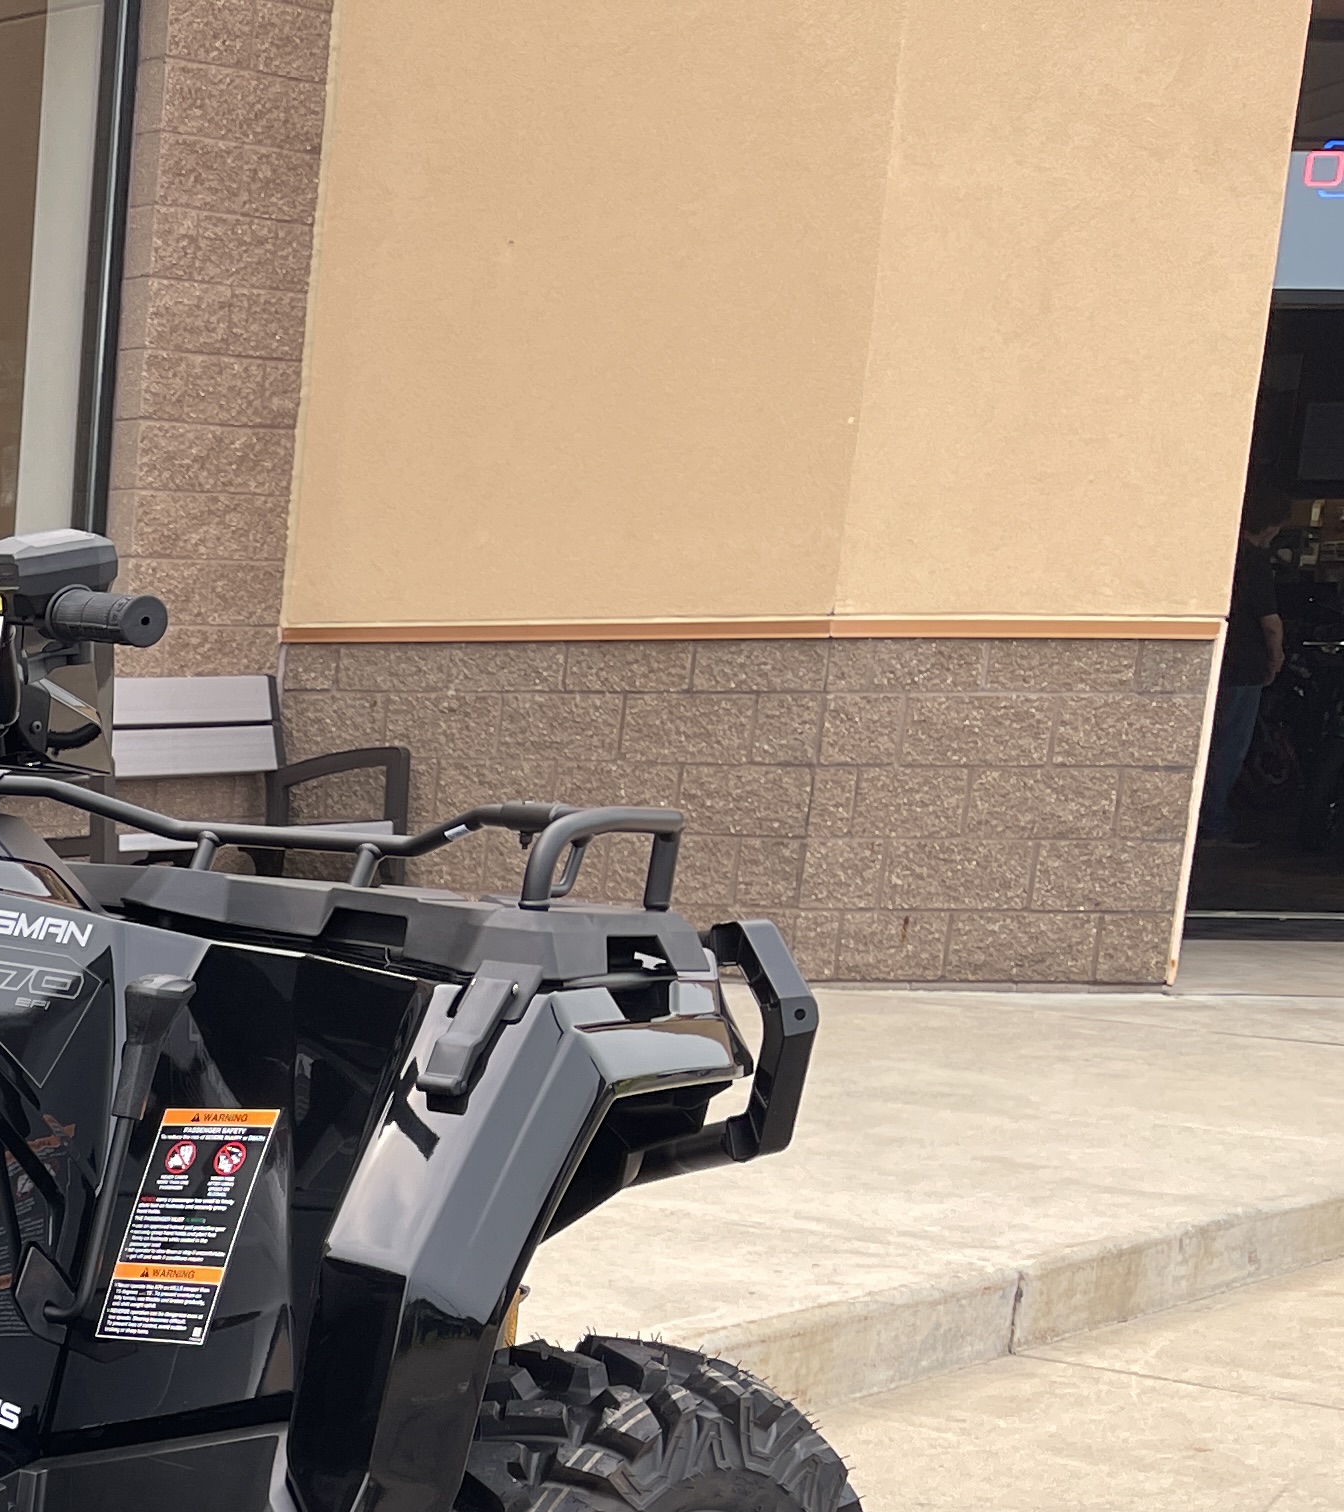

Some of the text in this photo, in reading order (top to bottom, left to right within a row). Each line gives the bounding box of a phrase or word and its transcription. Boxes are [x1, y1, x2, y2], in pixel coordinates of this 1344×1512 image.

[14, 996, 52, 1011] EFI
[203, 1113, 248, 1122] WARNING
[152, 1269, 195, 1279] WARNING
